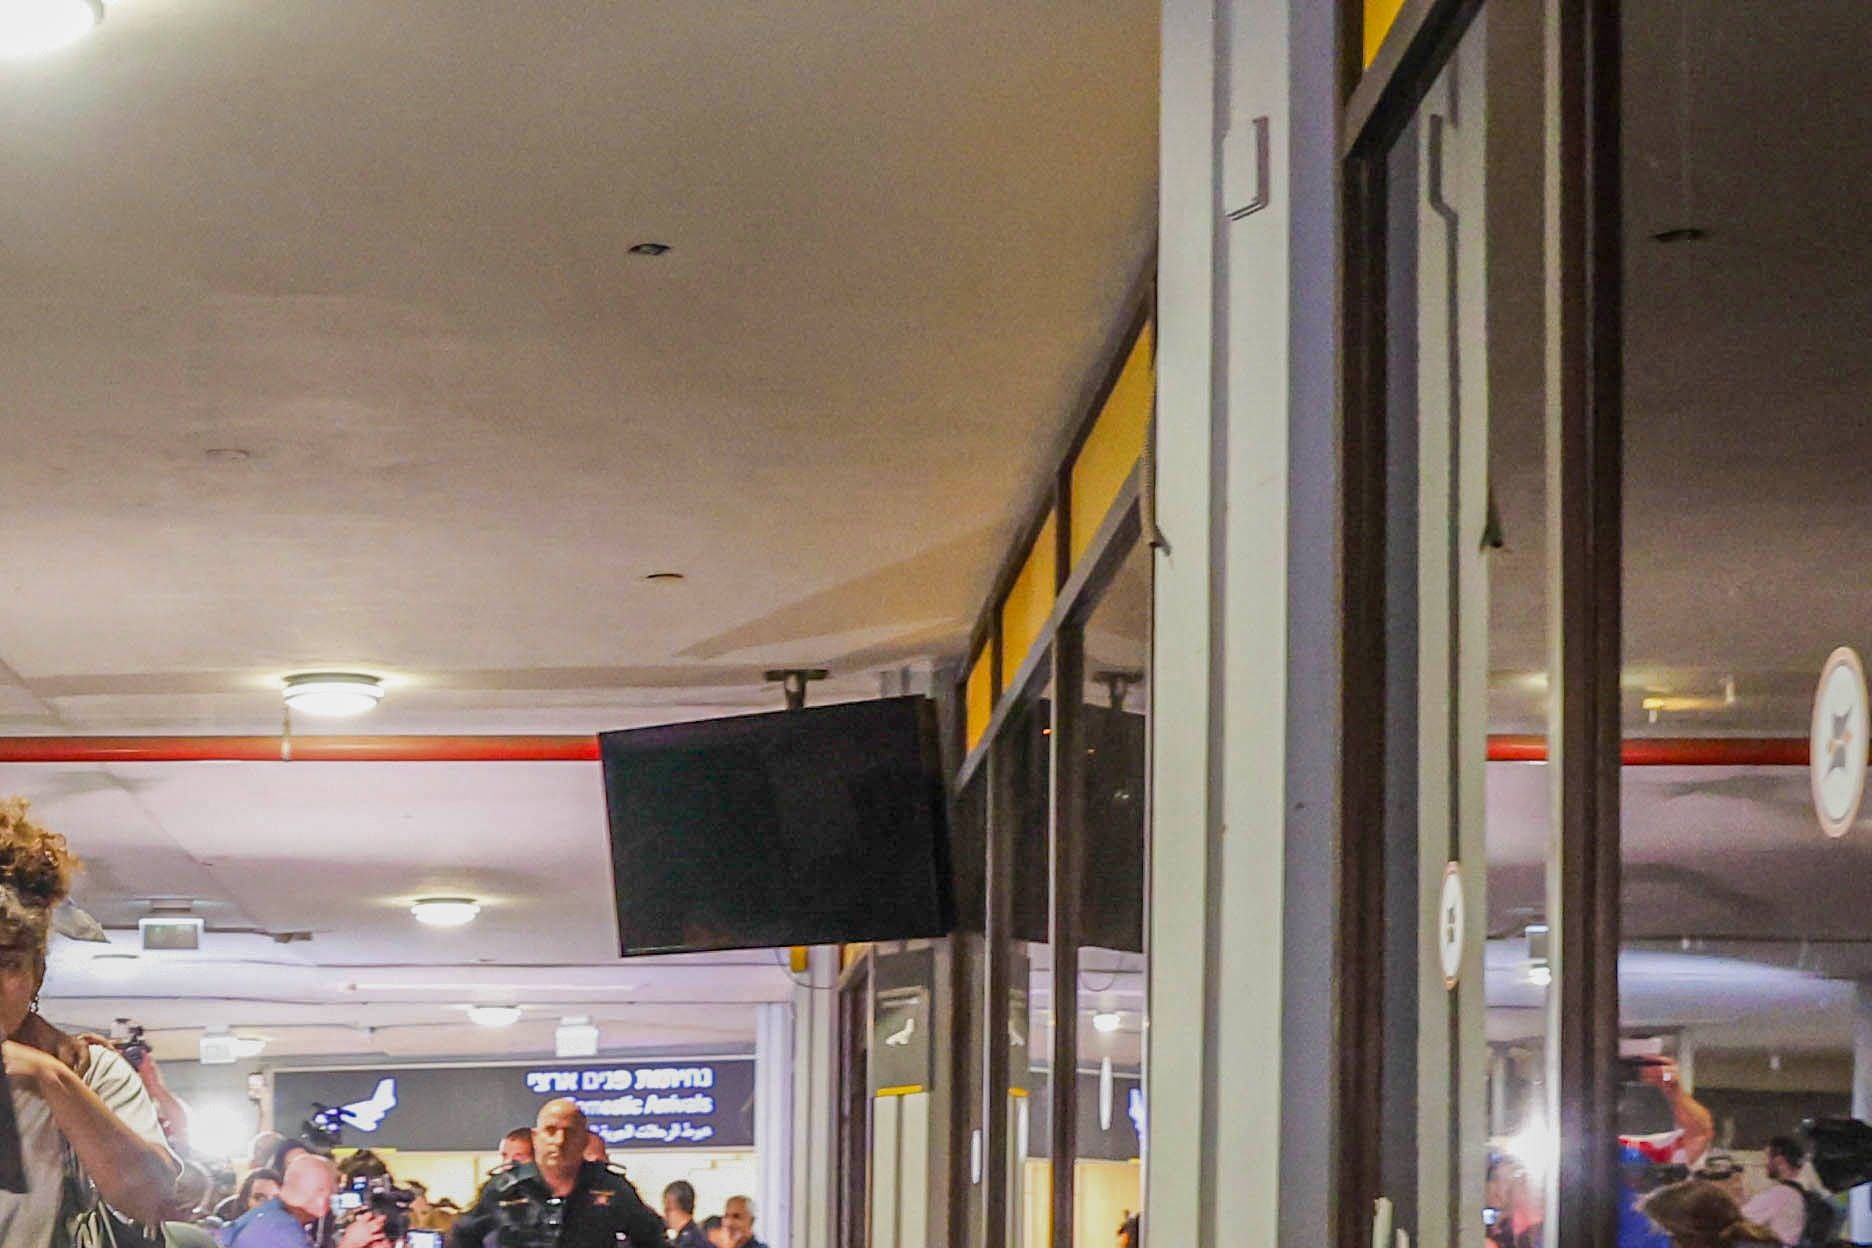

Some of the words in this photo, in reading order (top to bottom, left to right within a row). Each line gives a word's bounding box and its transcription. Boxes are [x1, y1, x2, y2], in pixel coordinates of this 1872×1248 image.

[527, 1072, 578, 1093] ארצי
[582, 1069, 632, 1091] פנים
[634, 1067, 713, 1090] נחיתות
[644, 1093, 714, 1114] Arrivals
